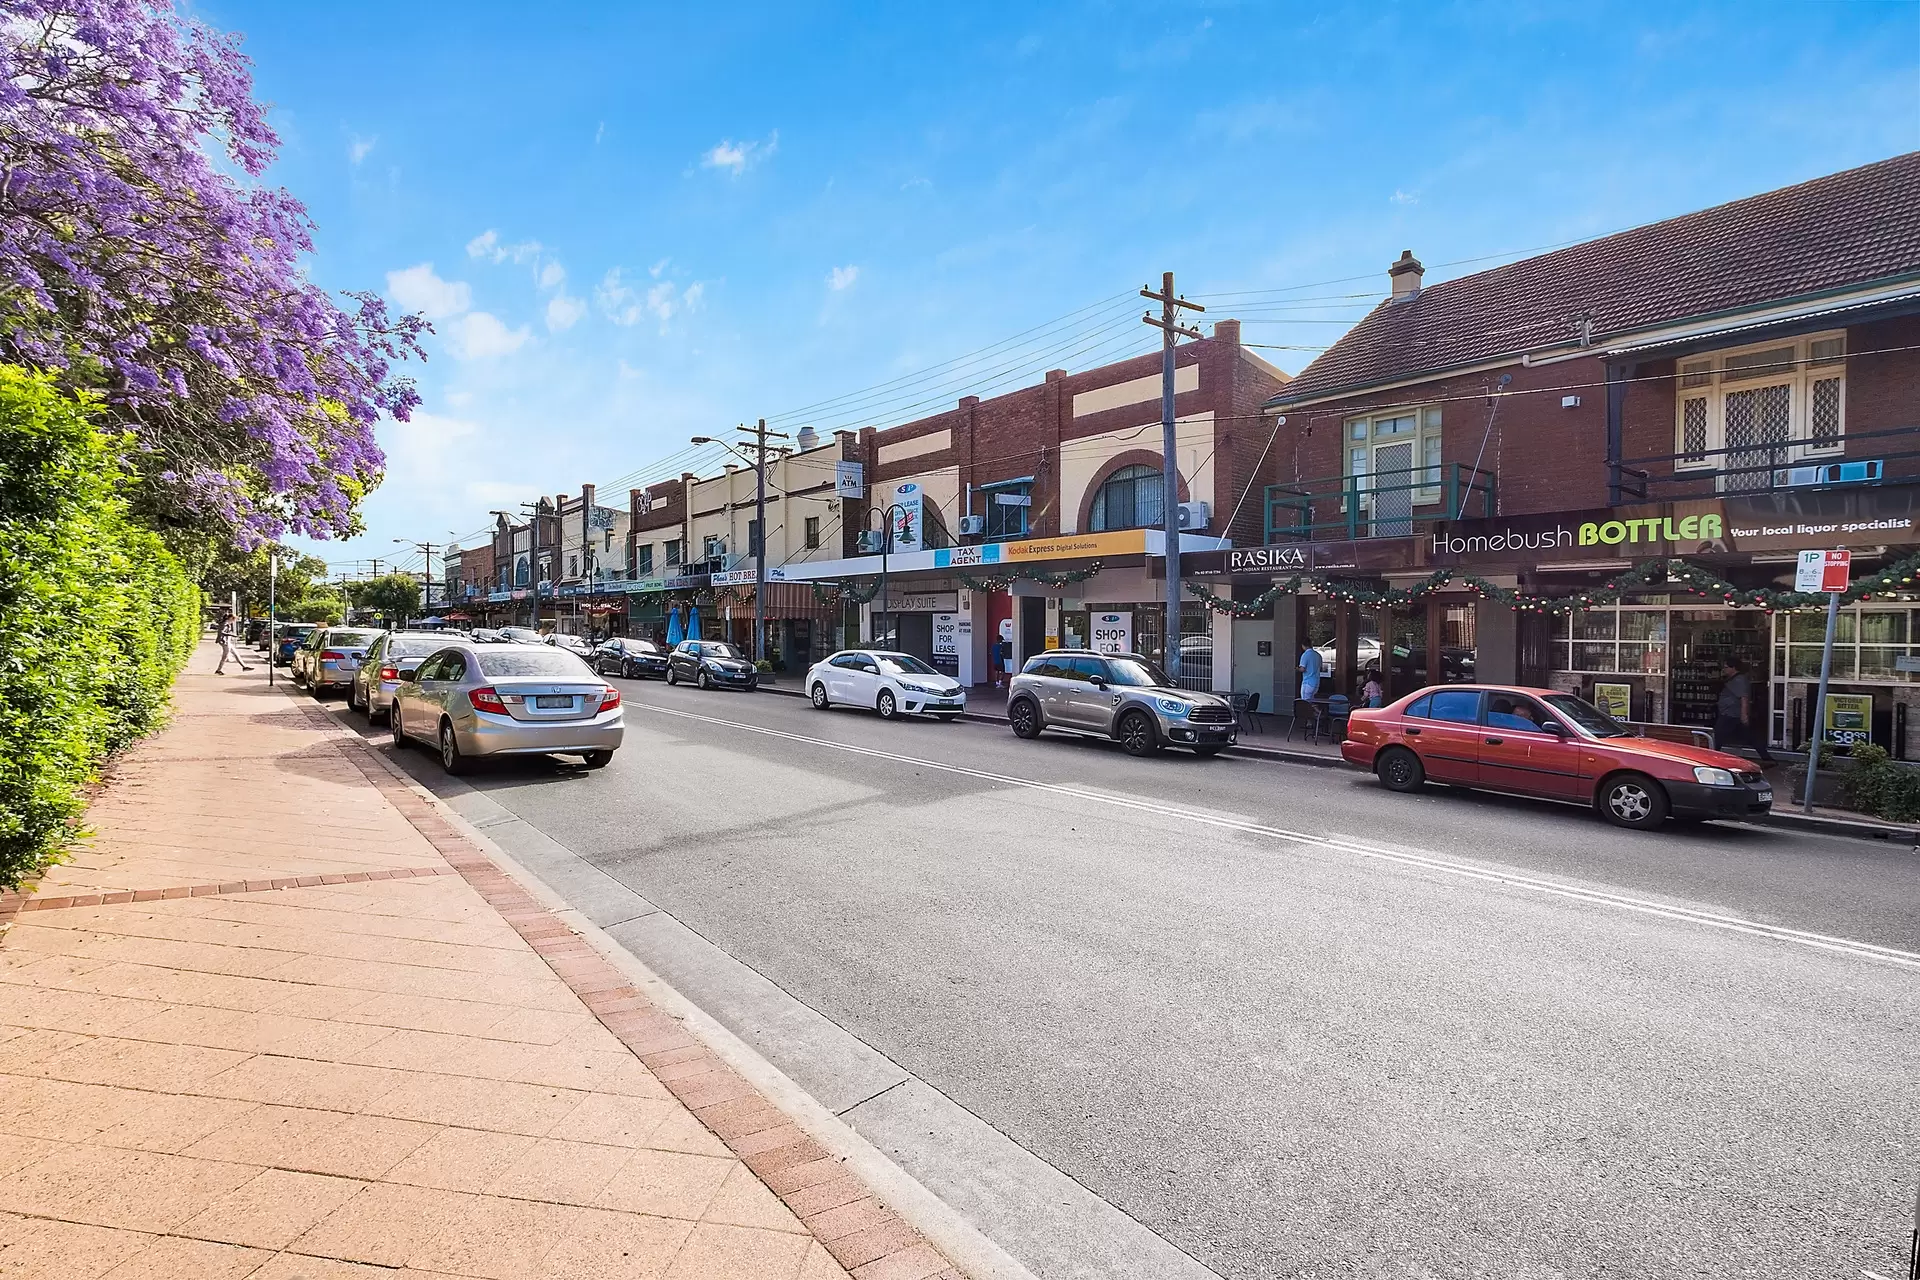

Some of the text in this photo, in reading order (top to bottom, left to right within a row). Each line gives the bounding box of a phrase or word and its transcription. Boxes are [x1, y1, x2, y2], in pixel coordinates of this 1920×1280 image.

[1731, 518, 1912, 538] Your local liquor specialist
[1432, 513, 1723, 554] Homebush BOTTLER
[957, 547, 975, 556] TAX
[1008, 542, 1098, 555] Kodak Express Digital Solutions
[950, 555, 982, 565] AGENT
[1231, 548, 1305, 567] RASIKA
[1804, 553, 1820, 563] 1P
[1831, 552, 1843, 560] NO
[729, 572, 742, 580] HOT
[743, 570, 758, 579] BRE
[887, 597, 937, 608] DISPLAY SUITE
[936, 624, 955, 632] SHOP
[938, 635, 952, 643] FOR
[1095, 629, 1126, 640] SHOP
[935, 645, 956, 653] LEASE
[1099, 643, 1122, 652] FOR
